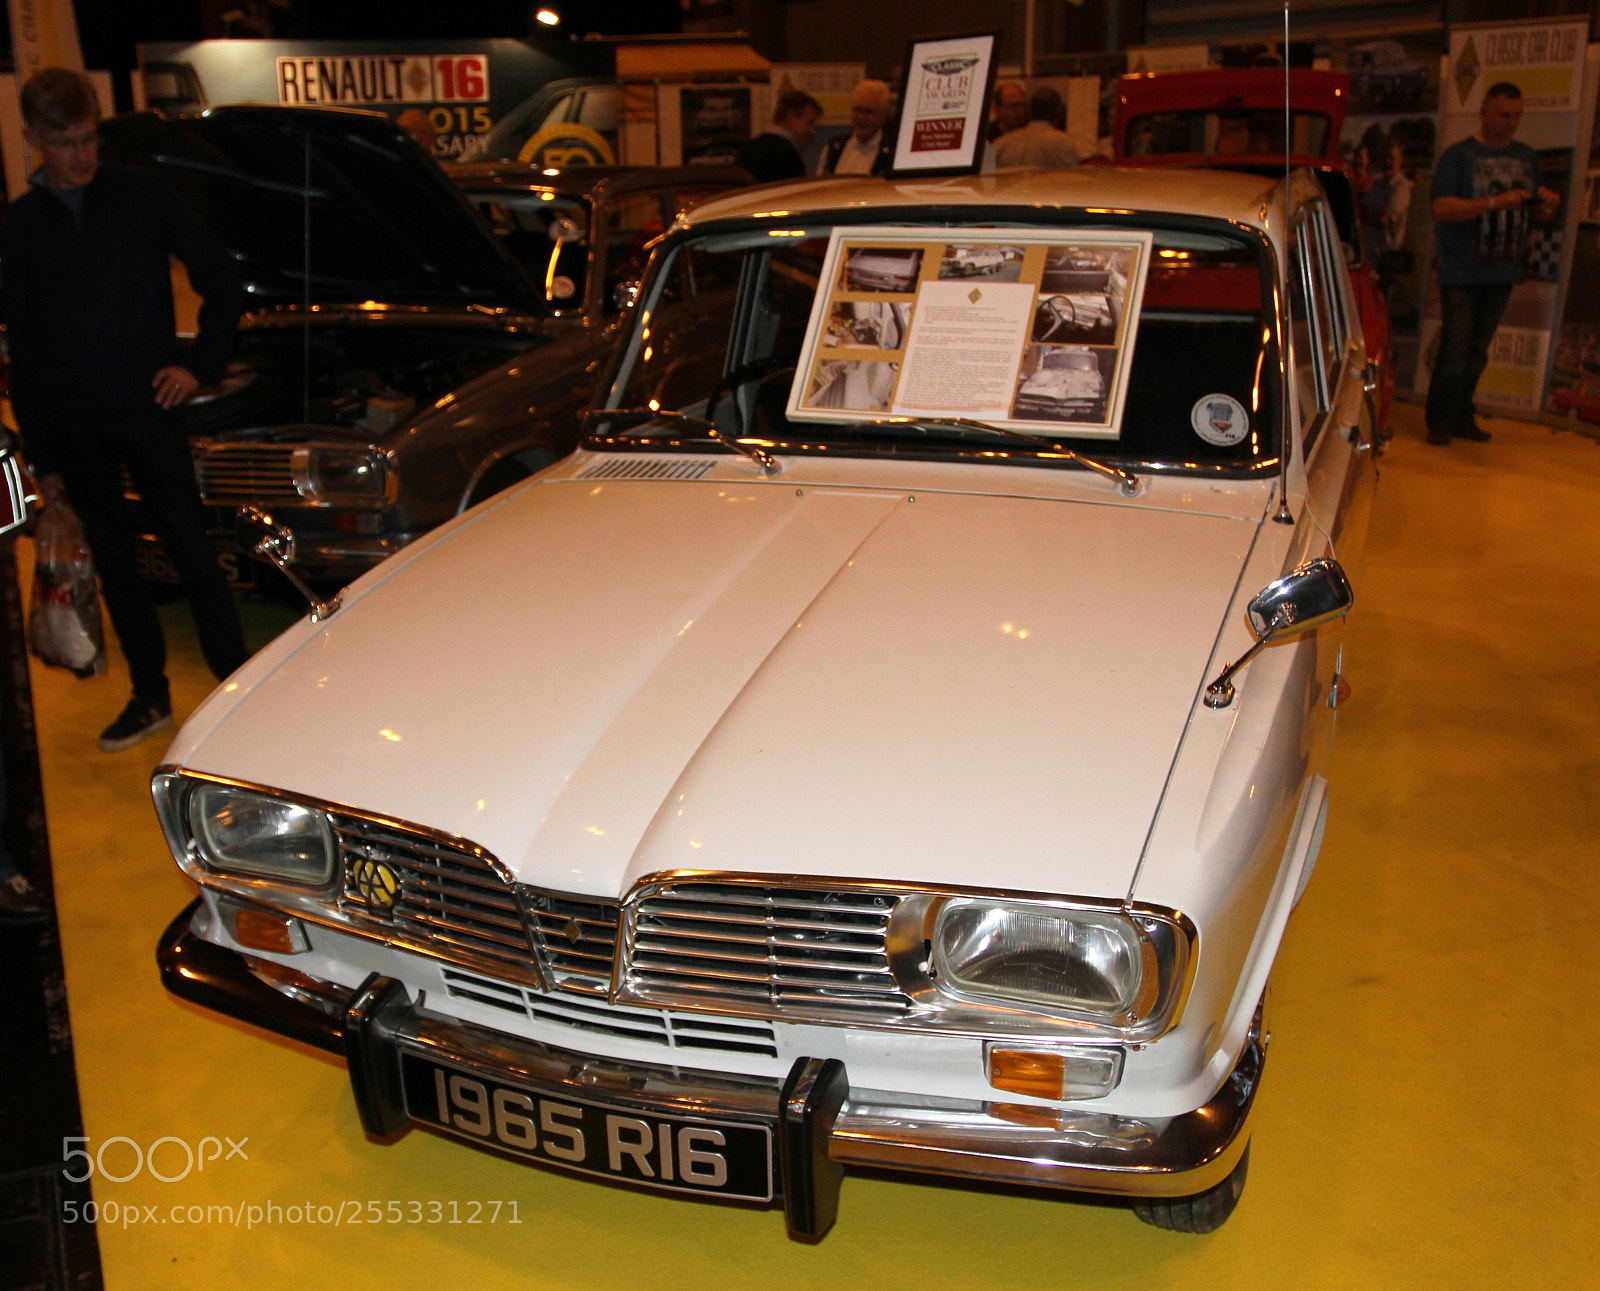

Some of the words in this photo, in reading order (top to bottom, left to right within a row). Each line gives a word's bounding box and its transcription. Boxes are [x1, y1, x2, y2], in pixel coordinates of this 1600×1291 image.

[281, 59, 405, 102] RENAULT
[438, 59, 484, 99] 16
[925, 75, 969, 91] CLUB
[429, 106, 493, 134] 015
[916, 120, 964, 133] WINNER
[433, 1068, 586, 1163] 1965
[605, 1114, 728, 1188] R16
